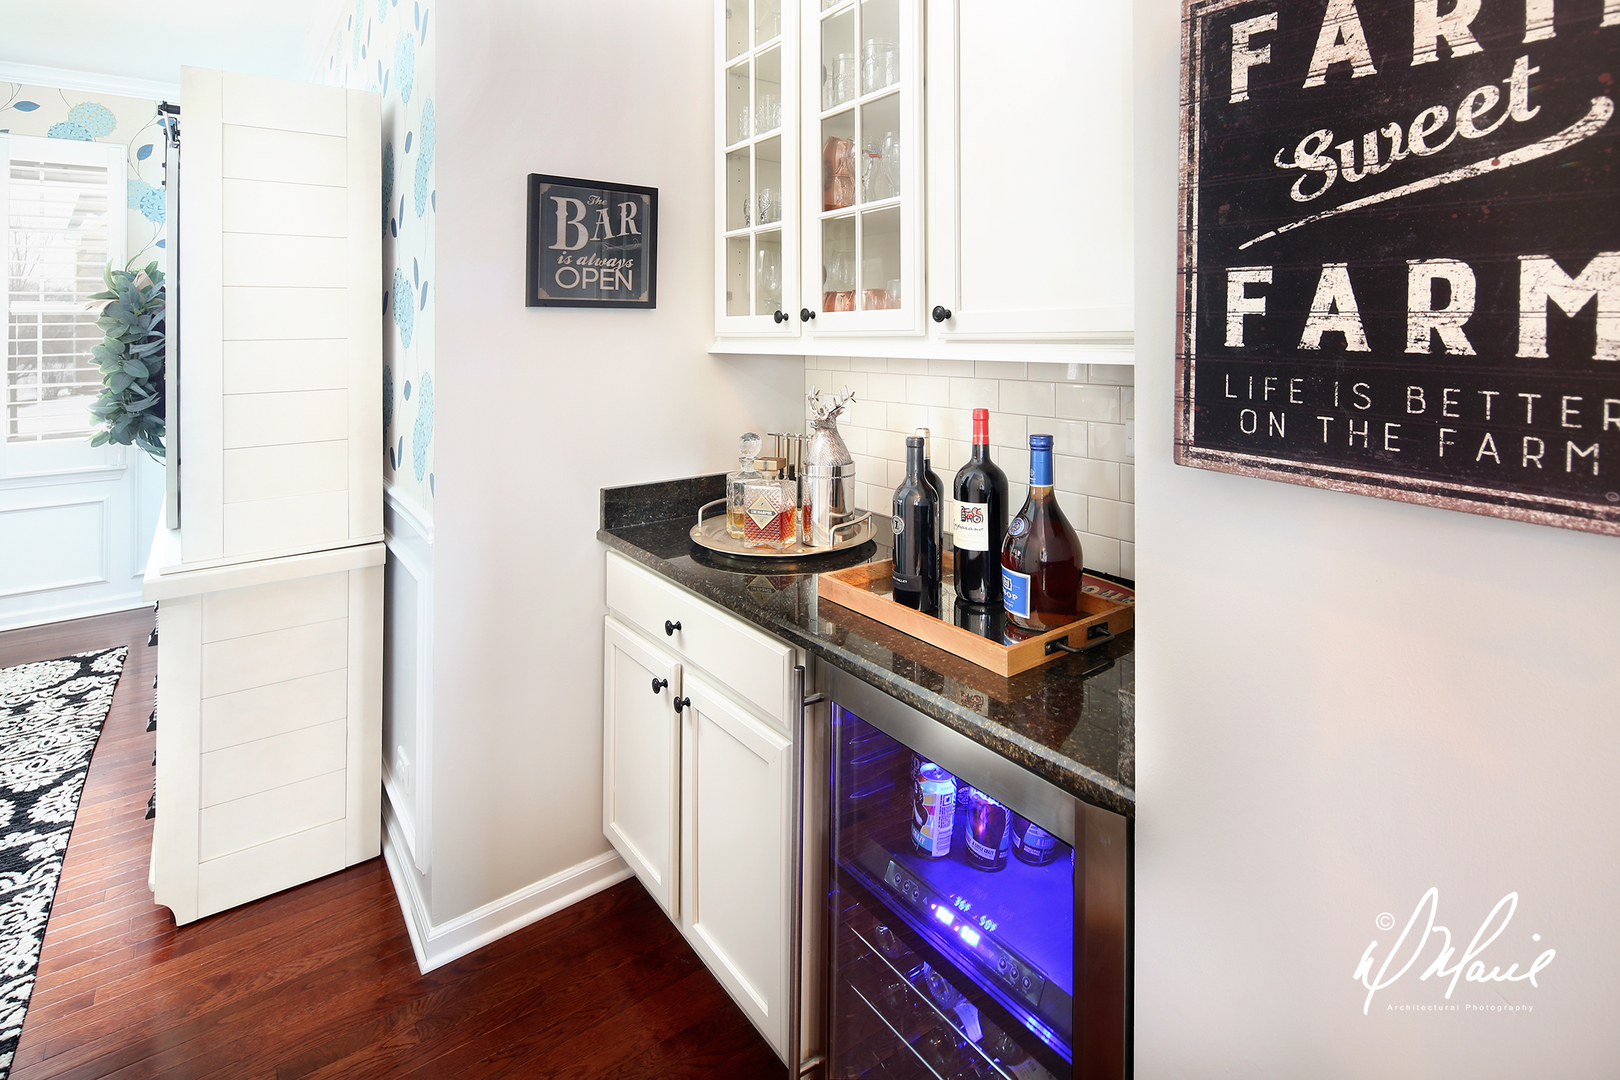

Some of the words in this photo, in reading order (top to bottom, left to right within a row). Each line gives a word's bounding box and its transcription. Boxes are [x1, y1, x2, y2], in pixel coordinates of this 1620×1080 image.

[1273, 54, 1541, 202] Sweet
[548, 195, 642, 251] BAR
[587, 194, 608, 206] The
[555, 266, 633, 291] OPEN
[557, 251, 572, 265] is
[576, 253, 634, 272] always
[1223, 251, 1620, 361] FARM
[1224, 373, 1304, 405] LIFE
[1334, 381, 1371, 410] IS
[1406, 385, 1620, 432] BETTER
[1239, 408, 1286, 438] ON
[1316, 415, 1401, 453] THE
[1440, 428, 1599, 476] FARM
